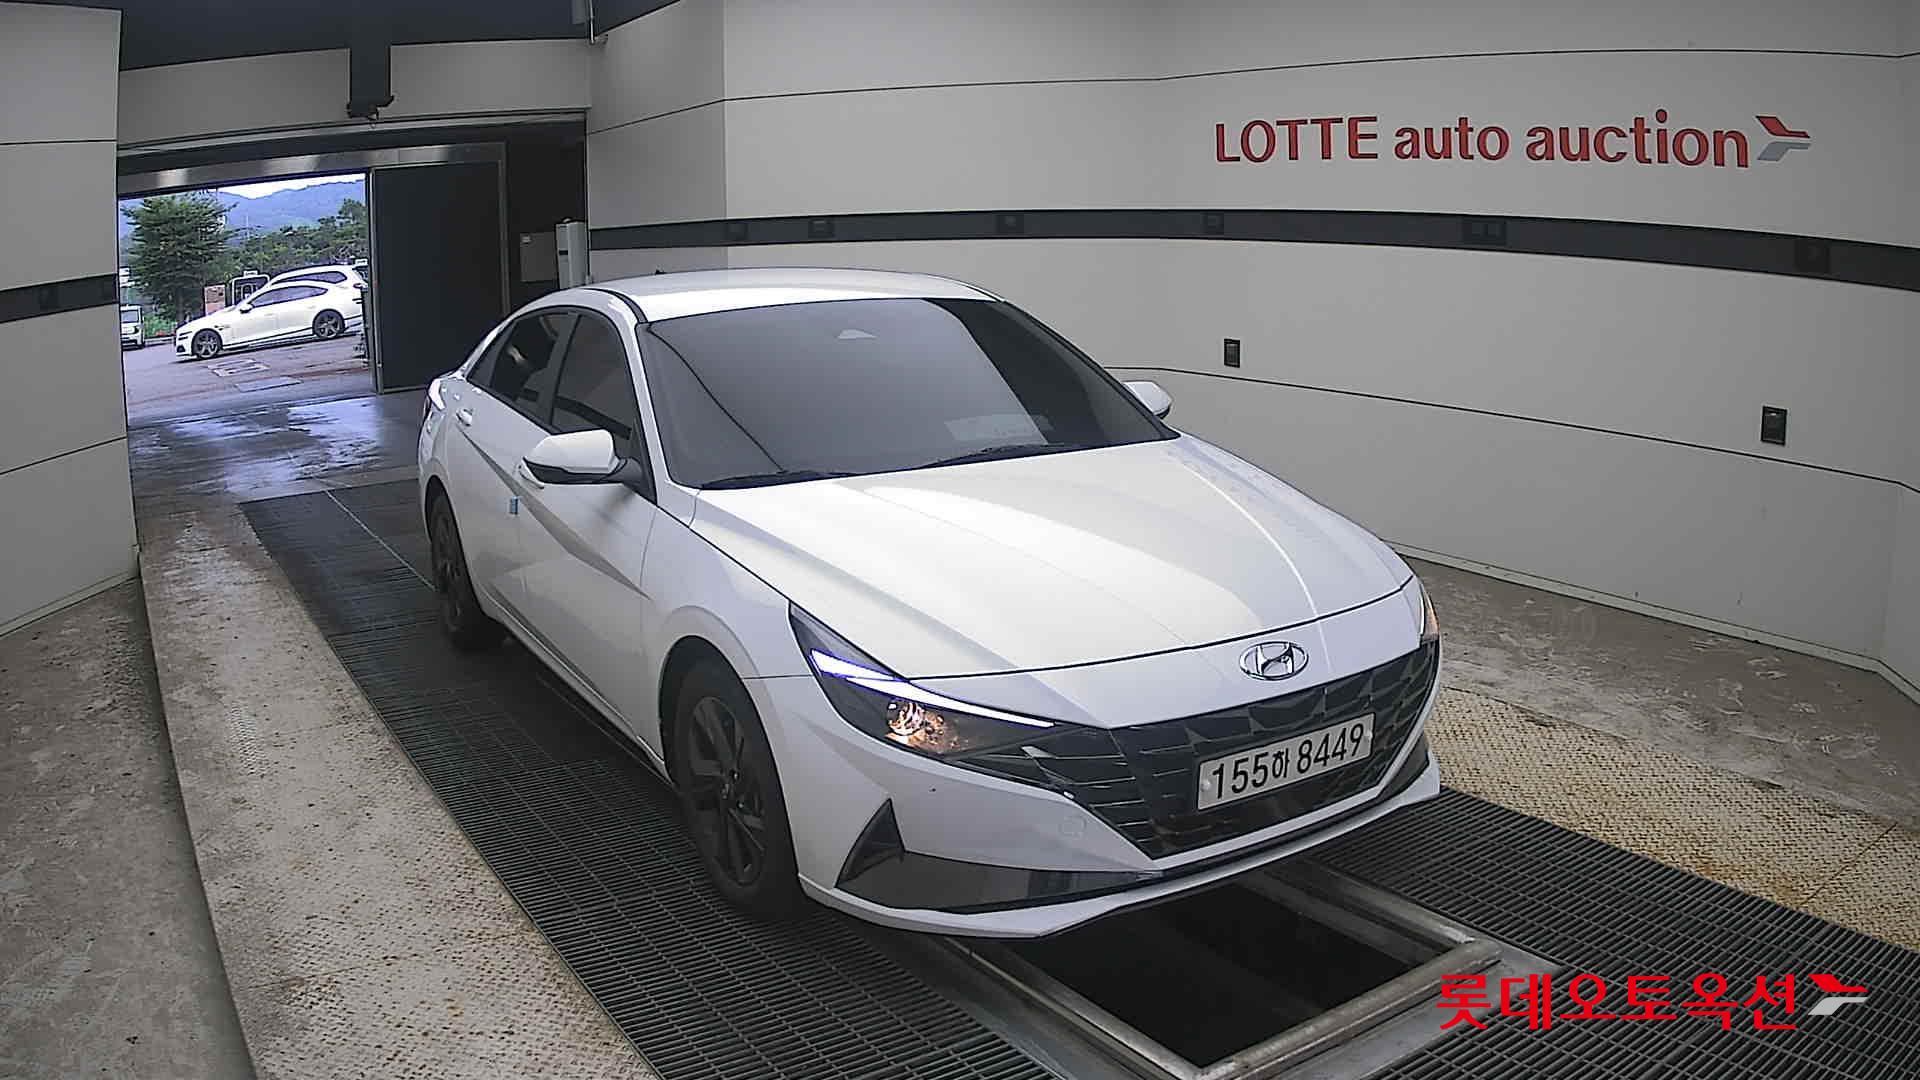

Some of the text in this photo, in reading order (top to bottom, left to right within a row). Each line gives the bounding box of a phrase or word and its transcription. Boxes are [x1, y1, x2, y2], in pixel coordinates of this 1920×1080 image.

[1215, 109, 1750, 168] LOTTE auto auction
[1212, 723, 1365, 799] 155하 8449
